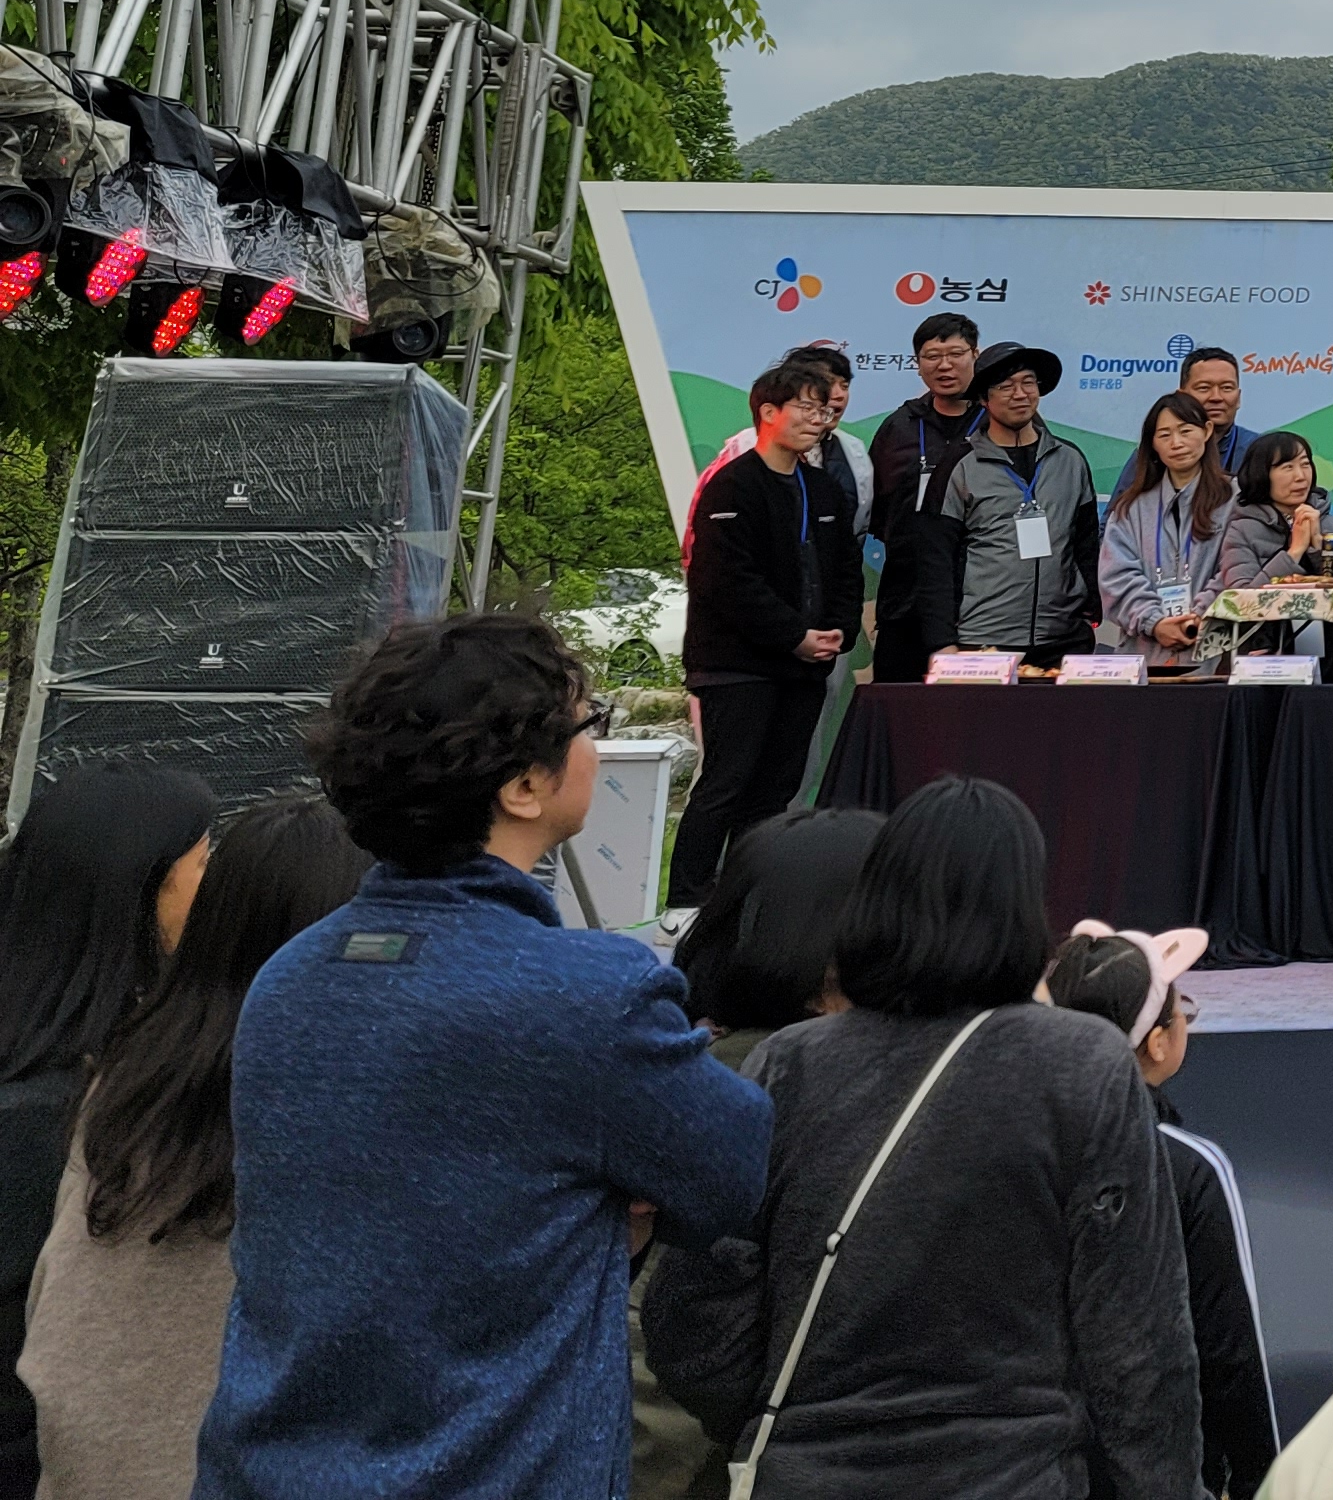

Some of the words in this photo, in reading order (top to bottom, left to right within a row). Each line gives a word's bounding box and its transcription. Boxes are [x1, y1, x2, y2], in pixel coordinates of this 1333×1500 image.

[754, 279, 782, 300] CJ
[939, 276, 1008, 303] 농심
[1120, 285, 1242, 304] SHINSEGAE
[1247, 286, 1311, 304] FOOD
[855, 353, 921, 371] 한돈자조
[1080, 354, 1178, 377] Dongwon
[1166, 605, 1183, 617] 13
